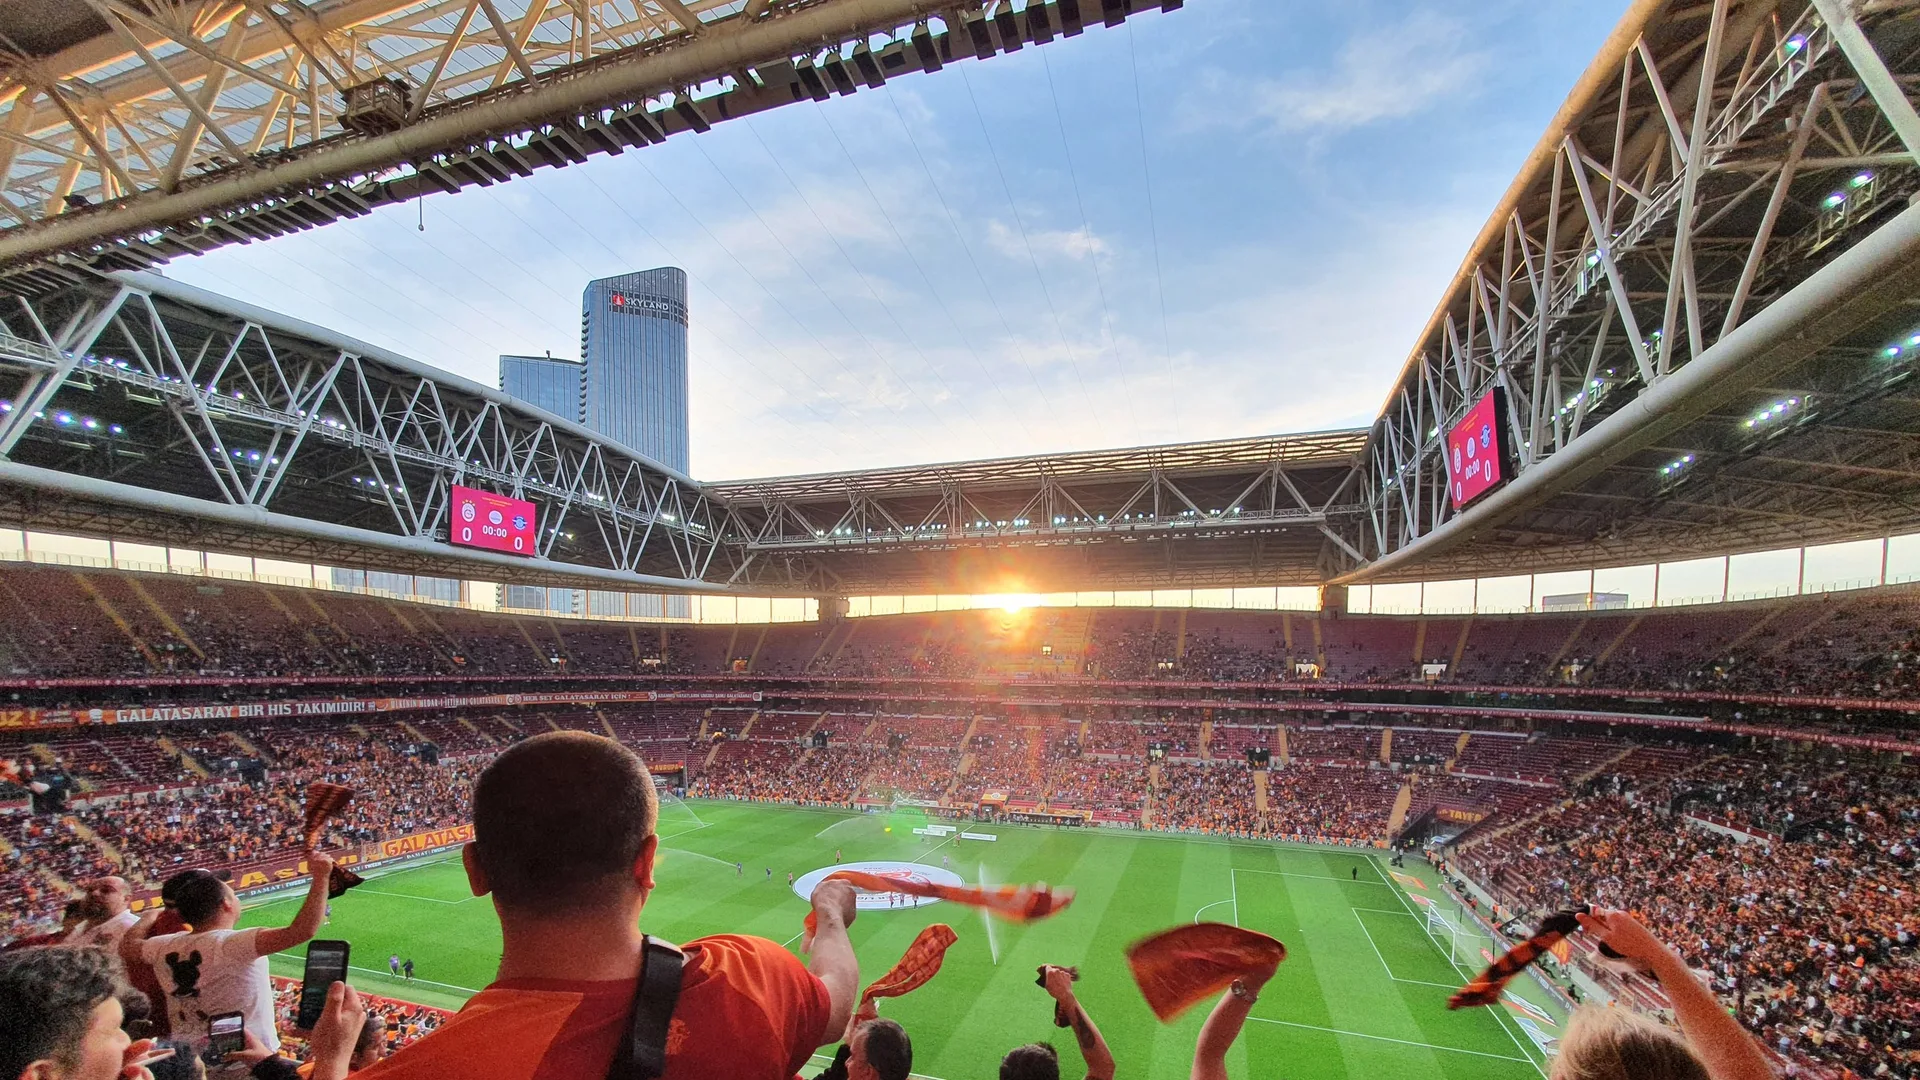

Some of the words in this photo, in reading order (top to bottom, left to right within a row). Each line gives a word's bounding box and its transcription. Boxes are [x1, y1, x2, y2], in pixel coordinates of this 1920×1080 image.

[625, 297, 669, 311] SKYLAND
[1465, 458, 1480, 480] 00:00
[1484, 459, 1491, 482] 0
[1456, 481, 1462, 502] 0
[462, 527, 472, 542] 0
[482, 525, 507, 538] 00:00
[514, 536, 523, 551] 0
[116, 706, 233, 722] GALATASARAY
[239, 703, 264, 717] BİR
[295, 702, 365, 714] TAKIMIDIR!
[407, 851, 428, 859] DAMAT
[250, 884, 280, 896] DAMAT
